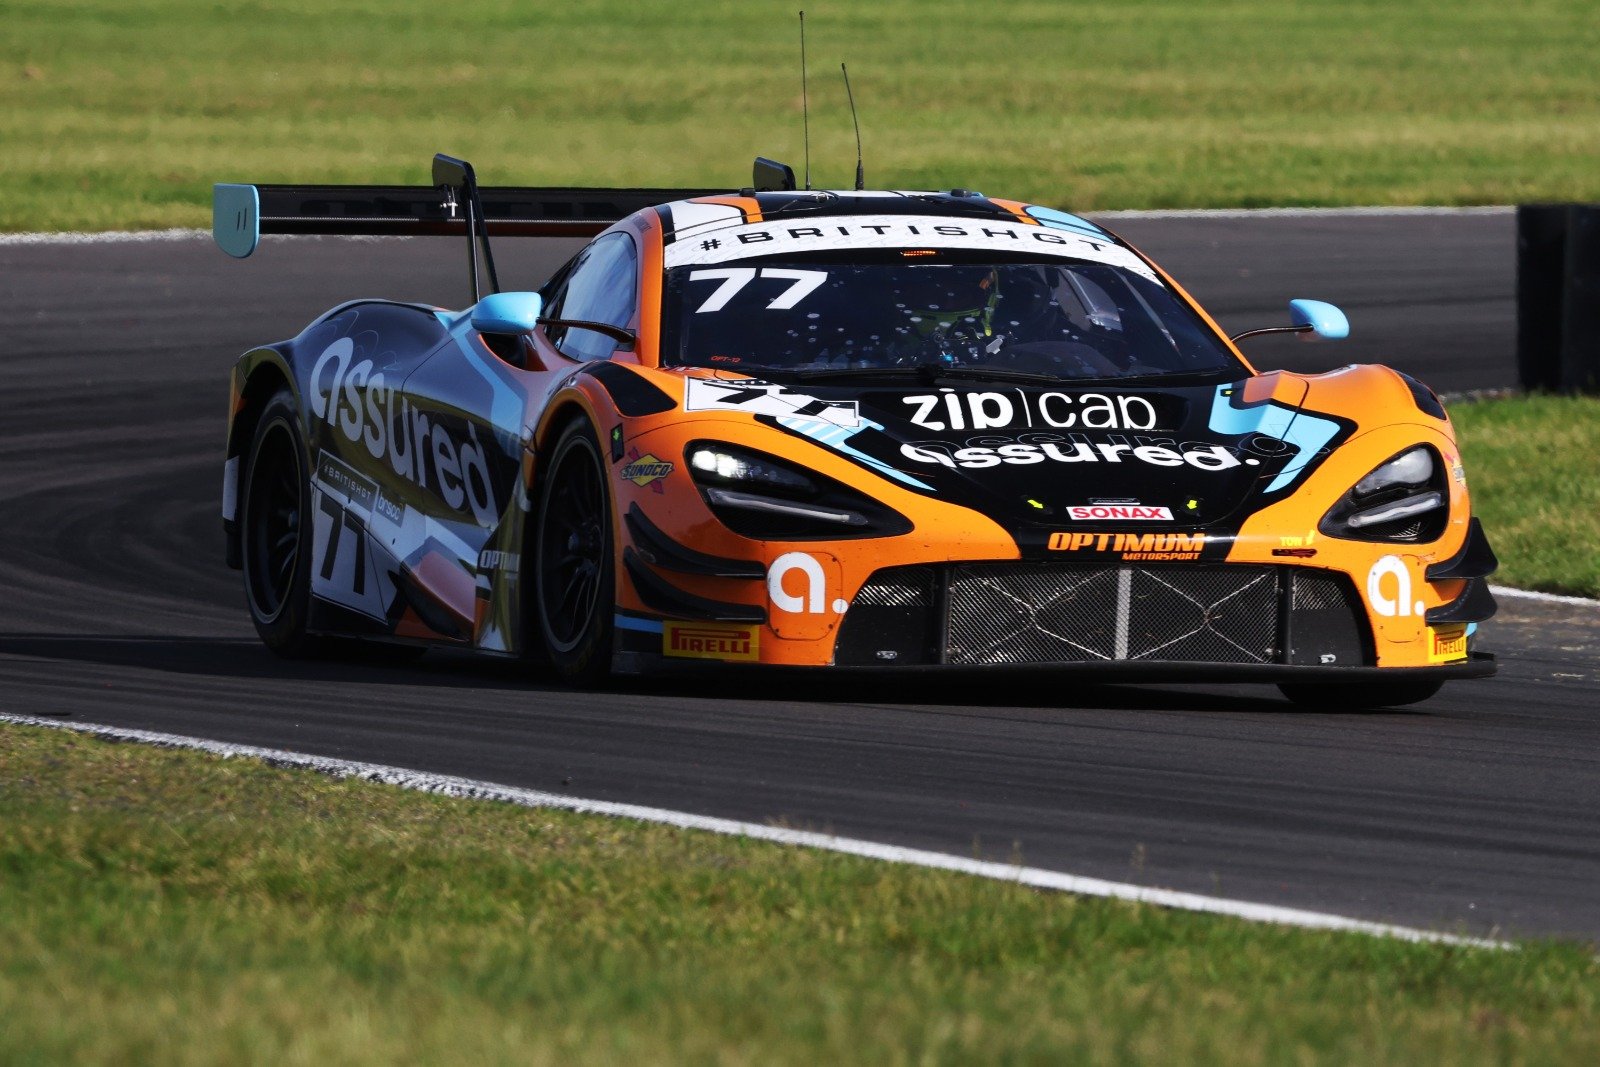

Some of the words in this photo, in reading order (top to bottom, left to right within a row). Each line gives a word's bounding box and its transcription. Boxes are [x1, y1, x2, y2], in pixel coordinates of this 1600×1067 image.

[700, 225, 1106, 252] #BRITISHGT
[689, 268, 828, 314] 77
[902, 388, 1014, 431] zip
[310, 336, 499, 530] assured
[622, 463, 671, 479] SUNOCO
[900, 443, 1261, 471] assured.
[1072, 507, 1165, 519] SONAX
[320, 493, 365, 596] 77
[1048, 532, 1205, 552] OPTIMUM
[1280, 536, 1303, 547] TOW
[671, 626, 751, 654] PIRELLI
